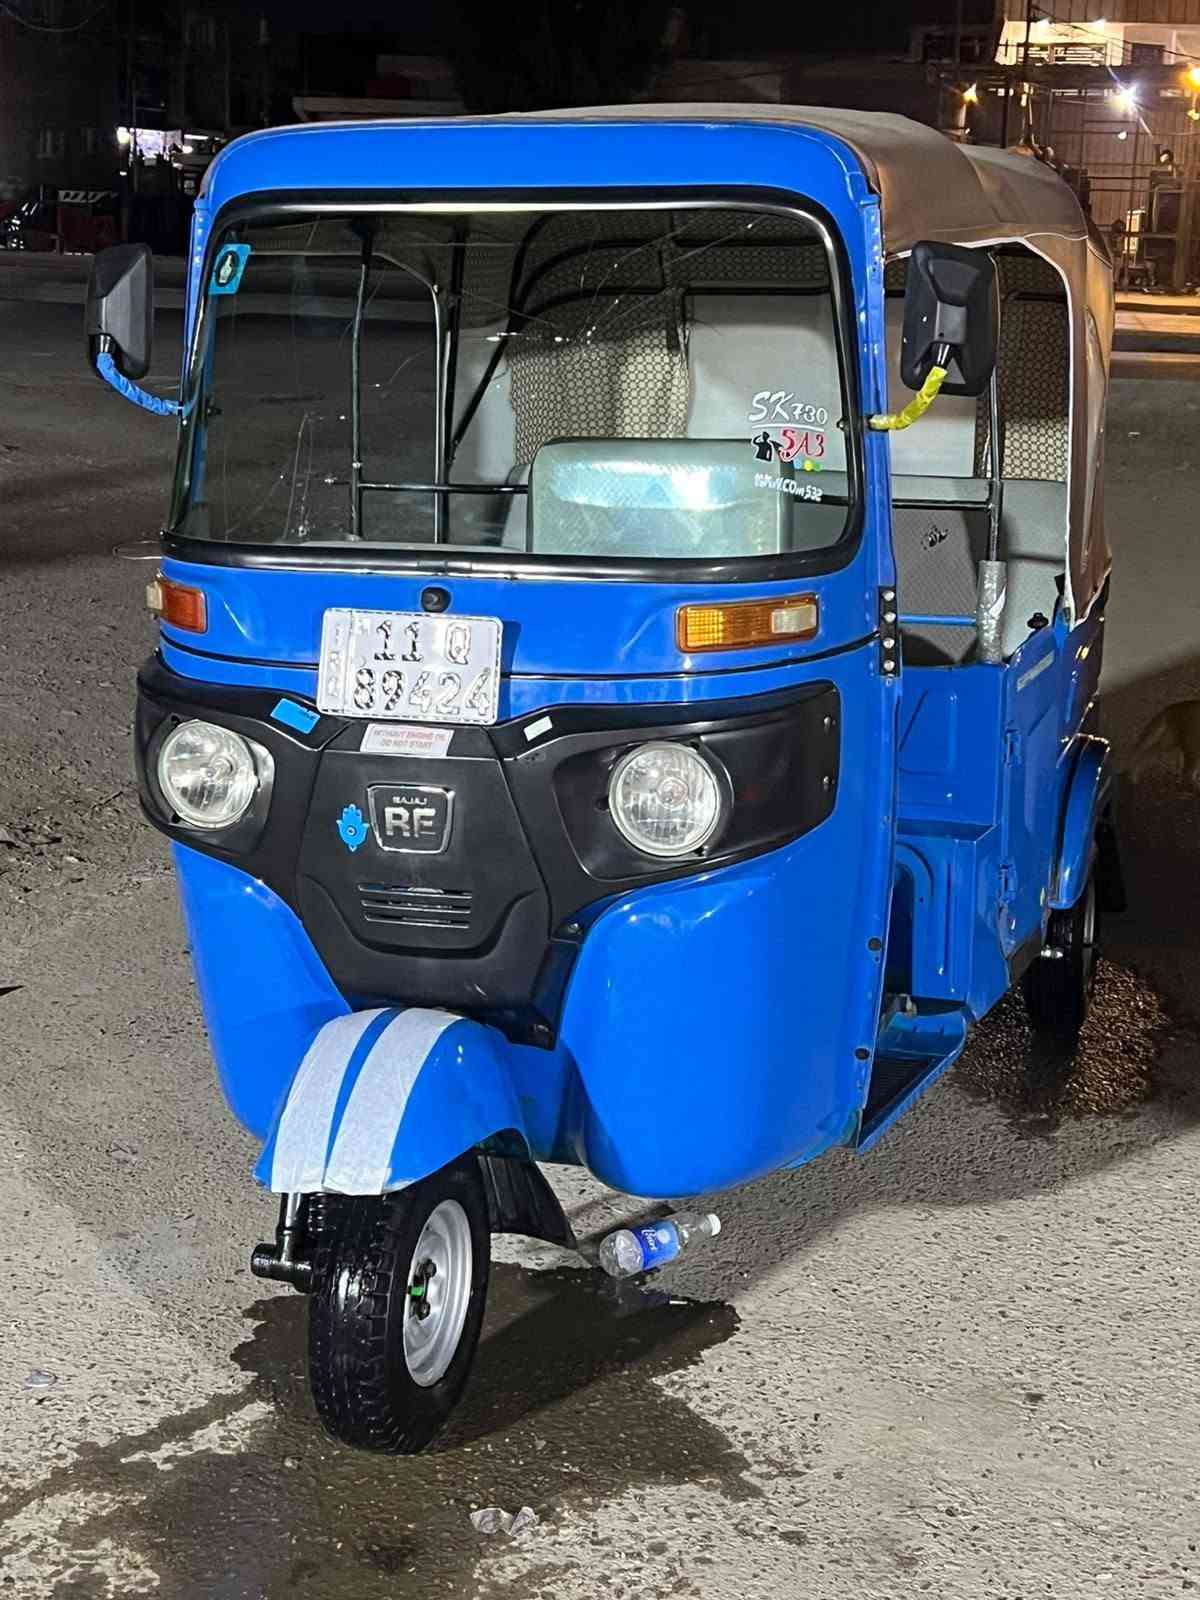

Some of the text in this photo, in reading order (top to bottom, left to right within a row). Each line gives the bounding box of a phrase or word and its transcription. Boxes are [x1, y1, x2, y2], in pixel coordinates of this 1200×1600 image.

[374, 619, 471, 665] 11 Q
[352, 667, 491, 717] 89424
